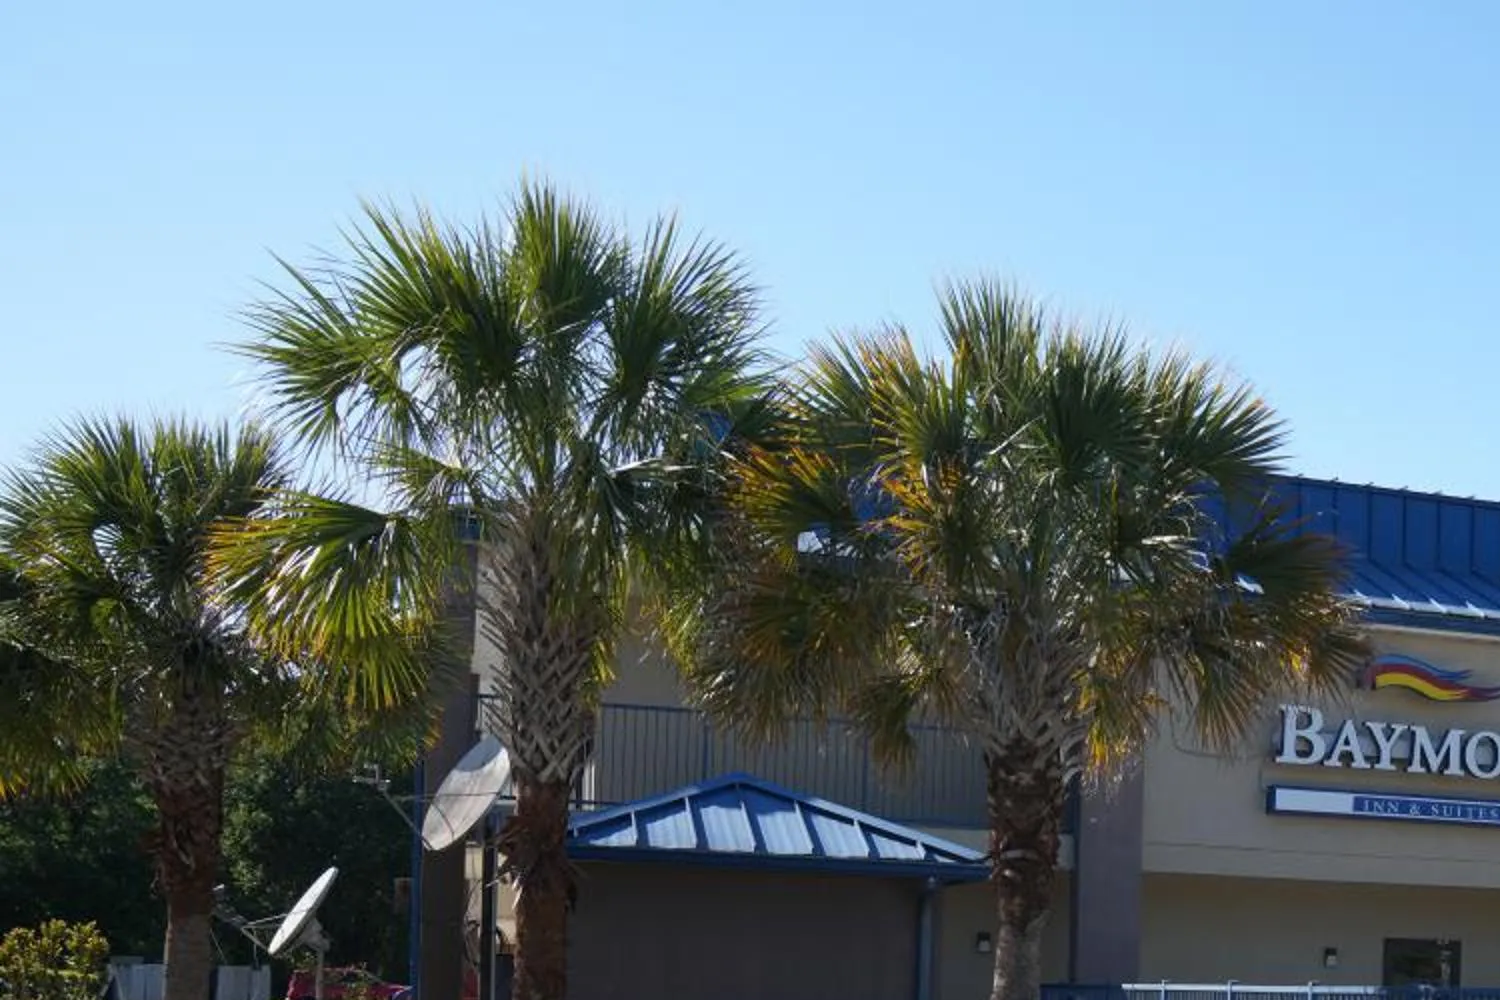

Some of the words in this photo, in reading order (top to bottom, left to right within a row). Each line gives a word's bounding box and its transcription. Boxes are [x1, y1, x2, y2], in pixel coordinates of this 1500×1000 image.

[1364, 799, 1400, 813] INN
[1409, 803, 1421, 816] &
[1431, 804, 1500, 820] SUITES
